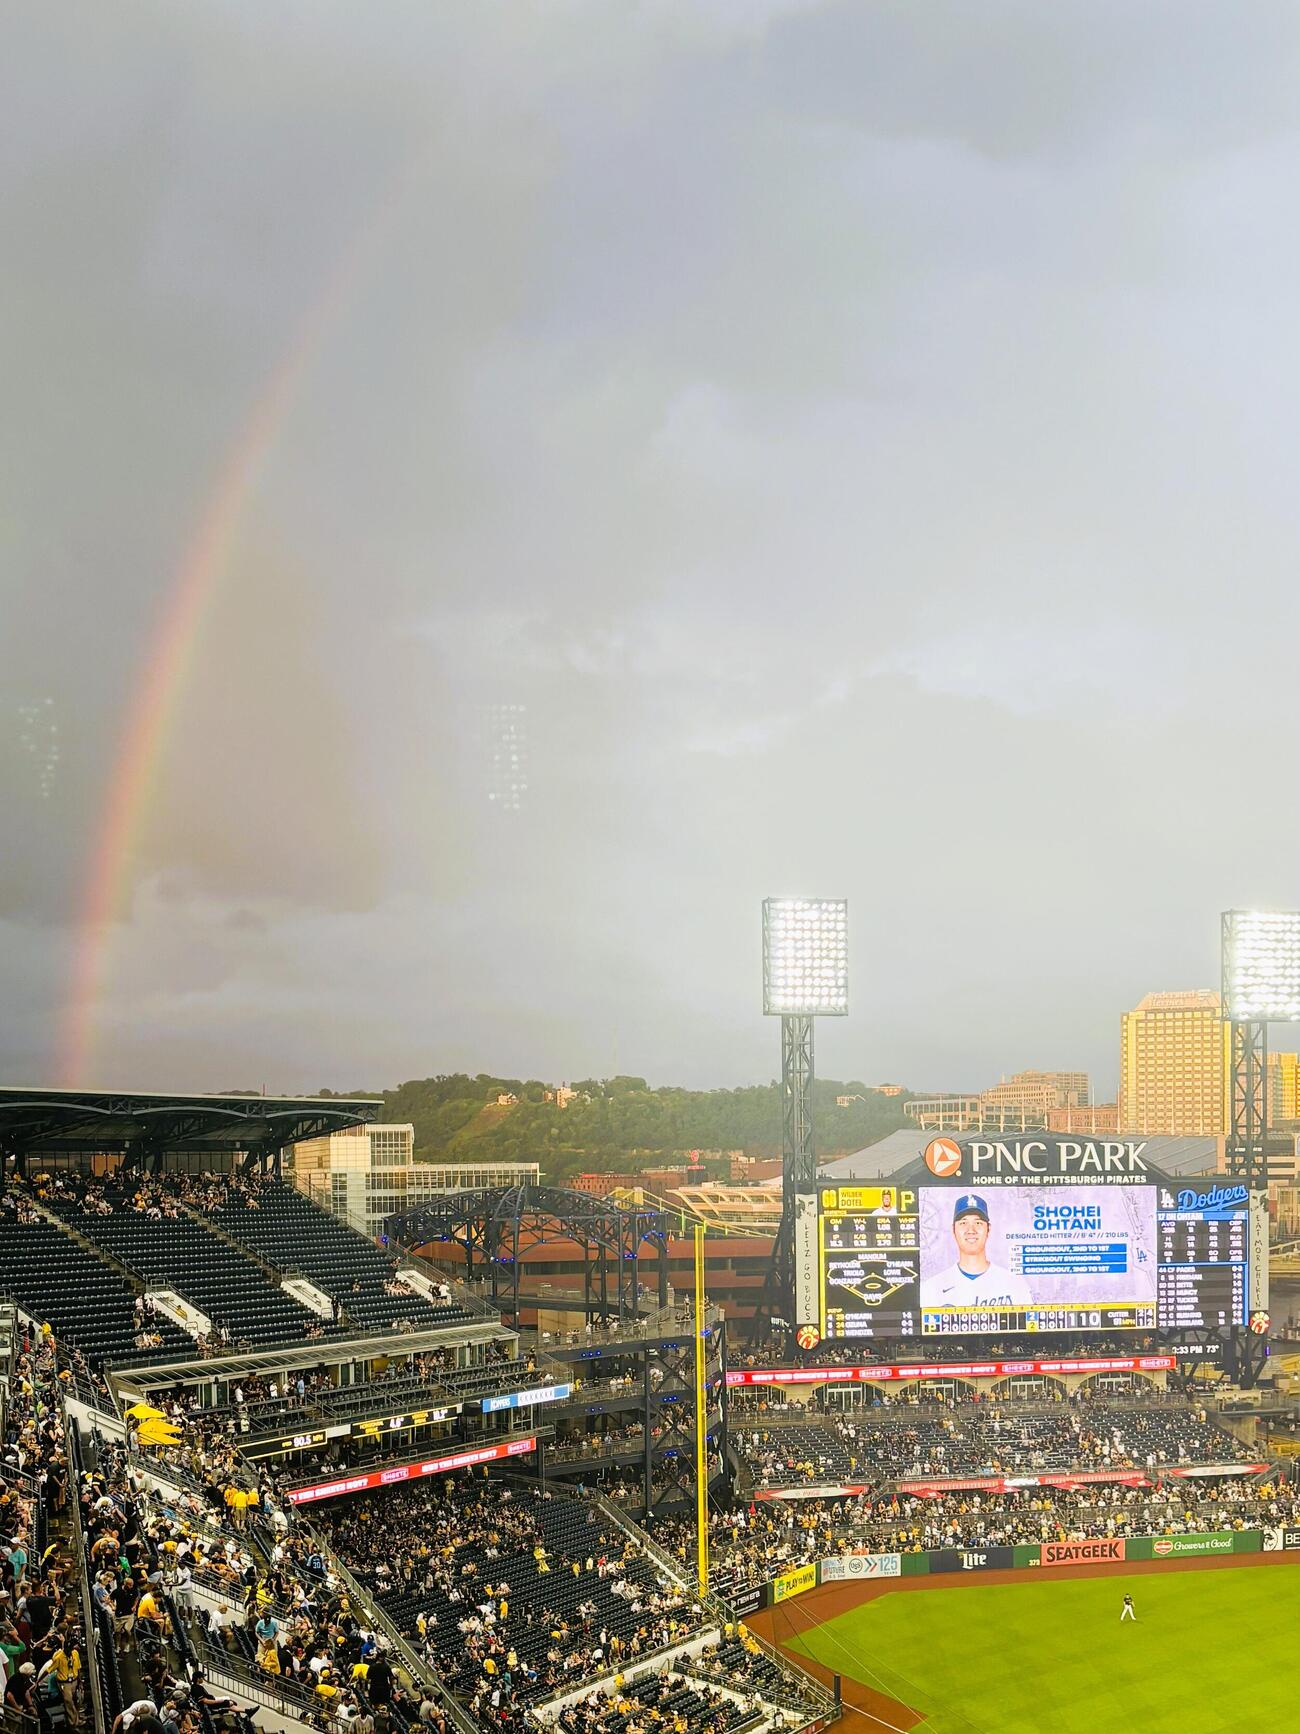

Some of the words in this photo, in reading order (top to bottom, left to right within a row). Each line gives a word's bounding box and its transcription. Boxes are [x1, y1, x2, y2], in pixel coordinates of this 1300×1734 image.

[968, 1142, 1048, 1172] PNC
[1056, 1142, 1148, 1172] PARK
[973, 1176, 1002, 1184] HOME
[1005, 1176, 1018, 1184] OF
[1022, 1176, 1040, 1184] THE
[1043, 1176, 1104, 1184] PITTSBURGH
[1107, 1175, 1147, 1184] PIRATES
[1160, 1188, 1175, 1208] LA
[1178, 1184, 1248, 1211] Dodgers
[1034, 1206, 1101, 1218] SHOHEI
[1034, 1219, 1101, 1230] OHTANI
[804, 1263, 811, 1280] GO
[1190, 1345, 1203, 1353] PM
[294, 1435, 312, 1447] 90.5
[1174, 1541, 1206, 1550] Growers
[1211, 1538, 1232, 1548] Good
[1046, 1542, 1120, 1562] SEATGEEK
[879, 1556, 898, 1571] 125
[962, 1552, 987, 1570] Lite
